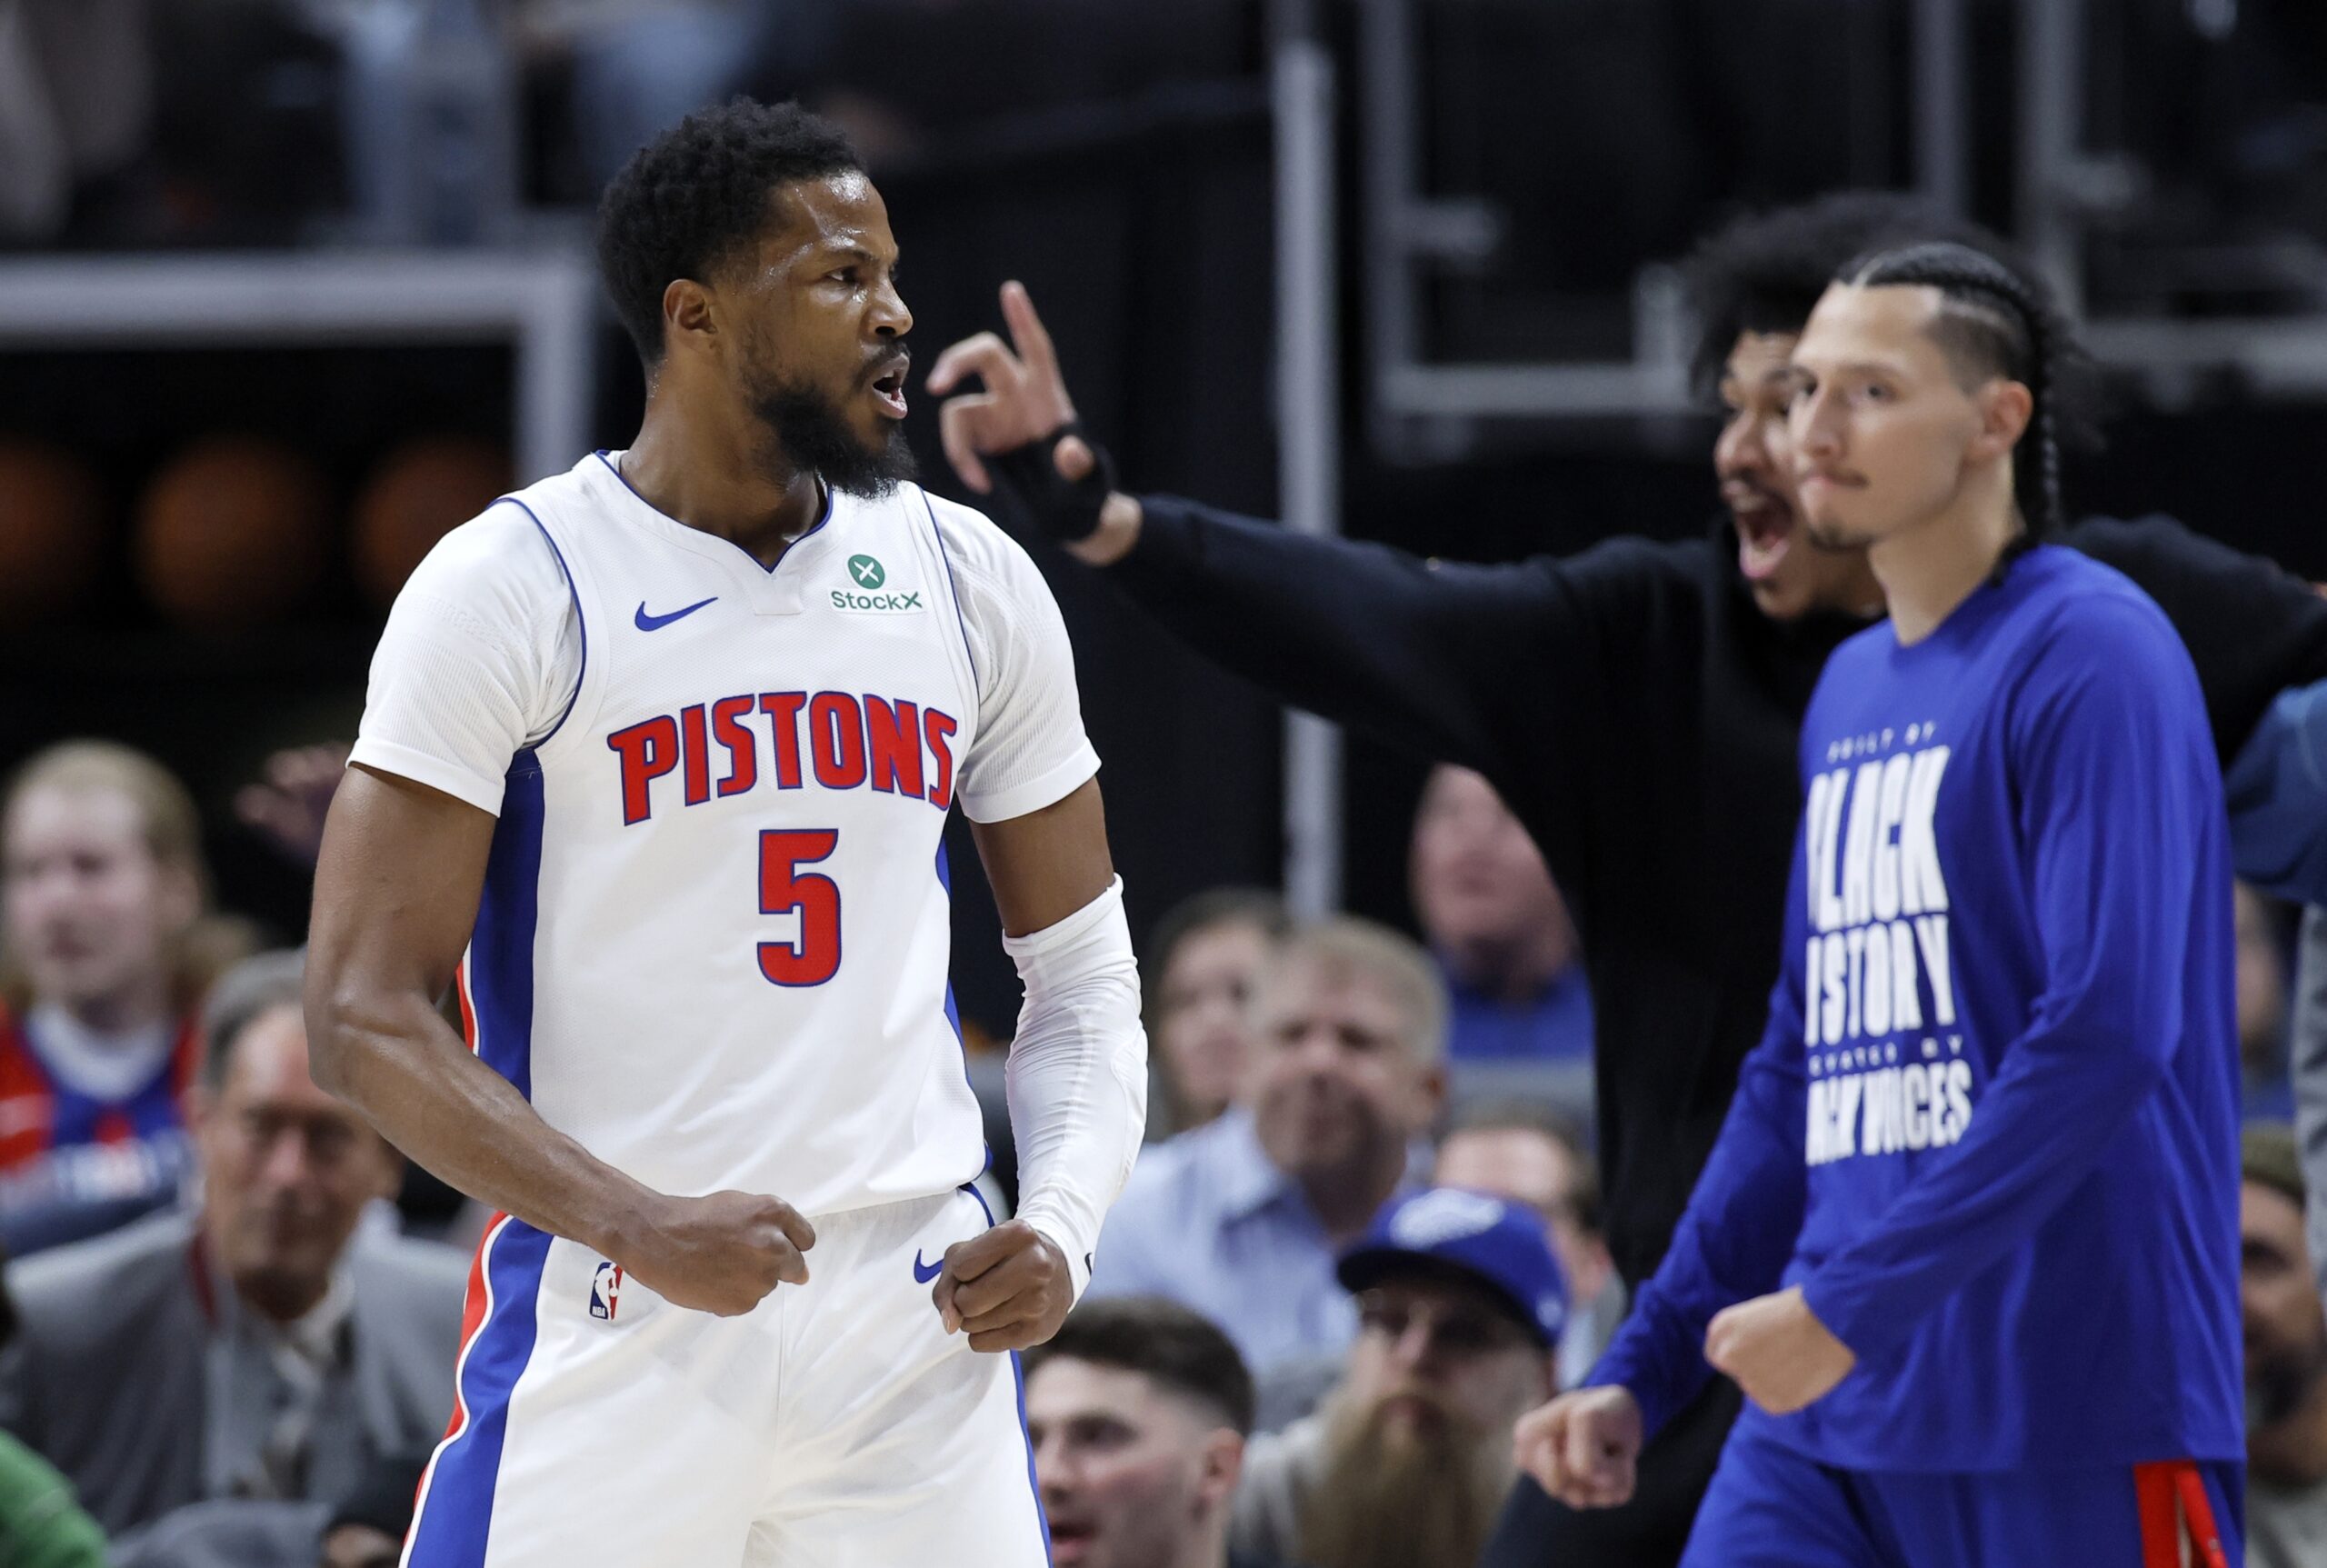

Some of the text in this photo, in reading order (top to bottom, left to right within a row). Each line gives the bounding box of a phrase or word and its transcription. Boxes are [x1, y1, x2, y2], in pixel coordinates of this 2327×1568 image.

[830, 590, 924, 610] StockX
[606, 690, 957, 826] PISTONS
[757, 827, 842, 988] 5
[1804, 913, 1956, 1048] ISTORY
